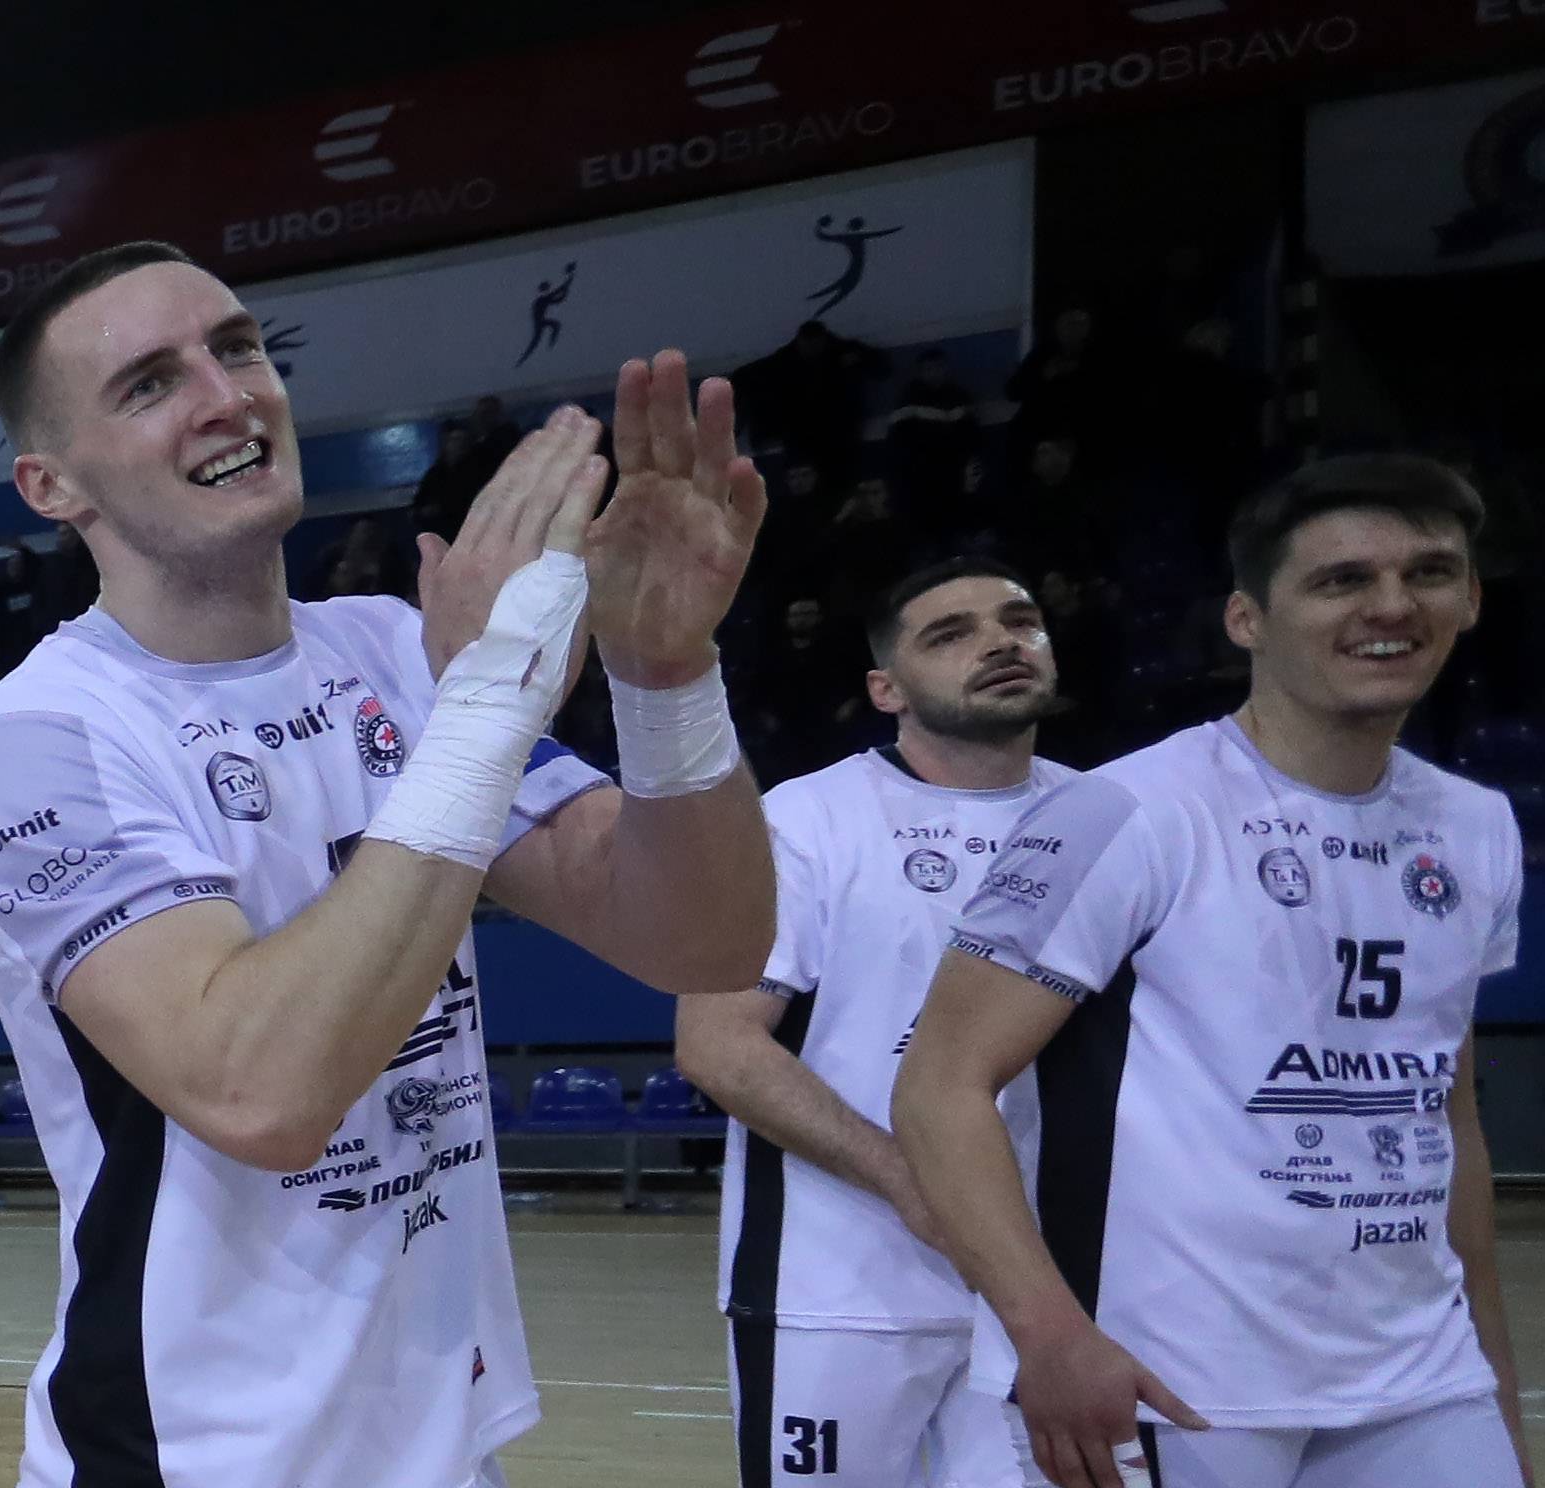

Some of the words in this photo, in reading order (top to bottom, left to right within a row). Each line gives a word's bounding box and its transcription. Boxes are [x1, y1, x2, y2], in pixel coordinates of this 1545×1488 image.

[993, 16, 1359, 112] EUROBRAVO
[579, 101, 894, 191] EUROBRAVO
[223, 177, 495, 253] EUROBRAVO
[199, 882, 226, 897] un
[1335, 937, 1405, 1018] 25
[1265, 1042, 1456, 1082] ADMIRA
[324, 1138, 365, 1158] НАВ
[1350, 1216, 1427, 1252] jazak
[782, 1415, 838, 1475] 31
